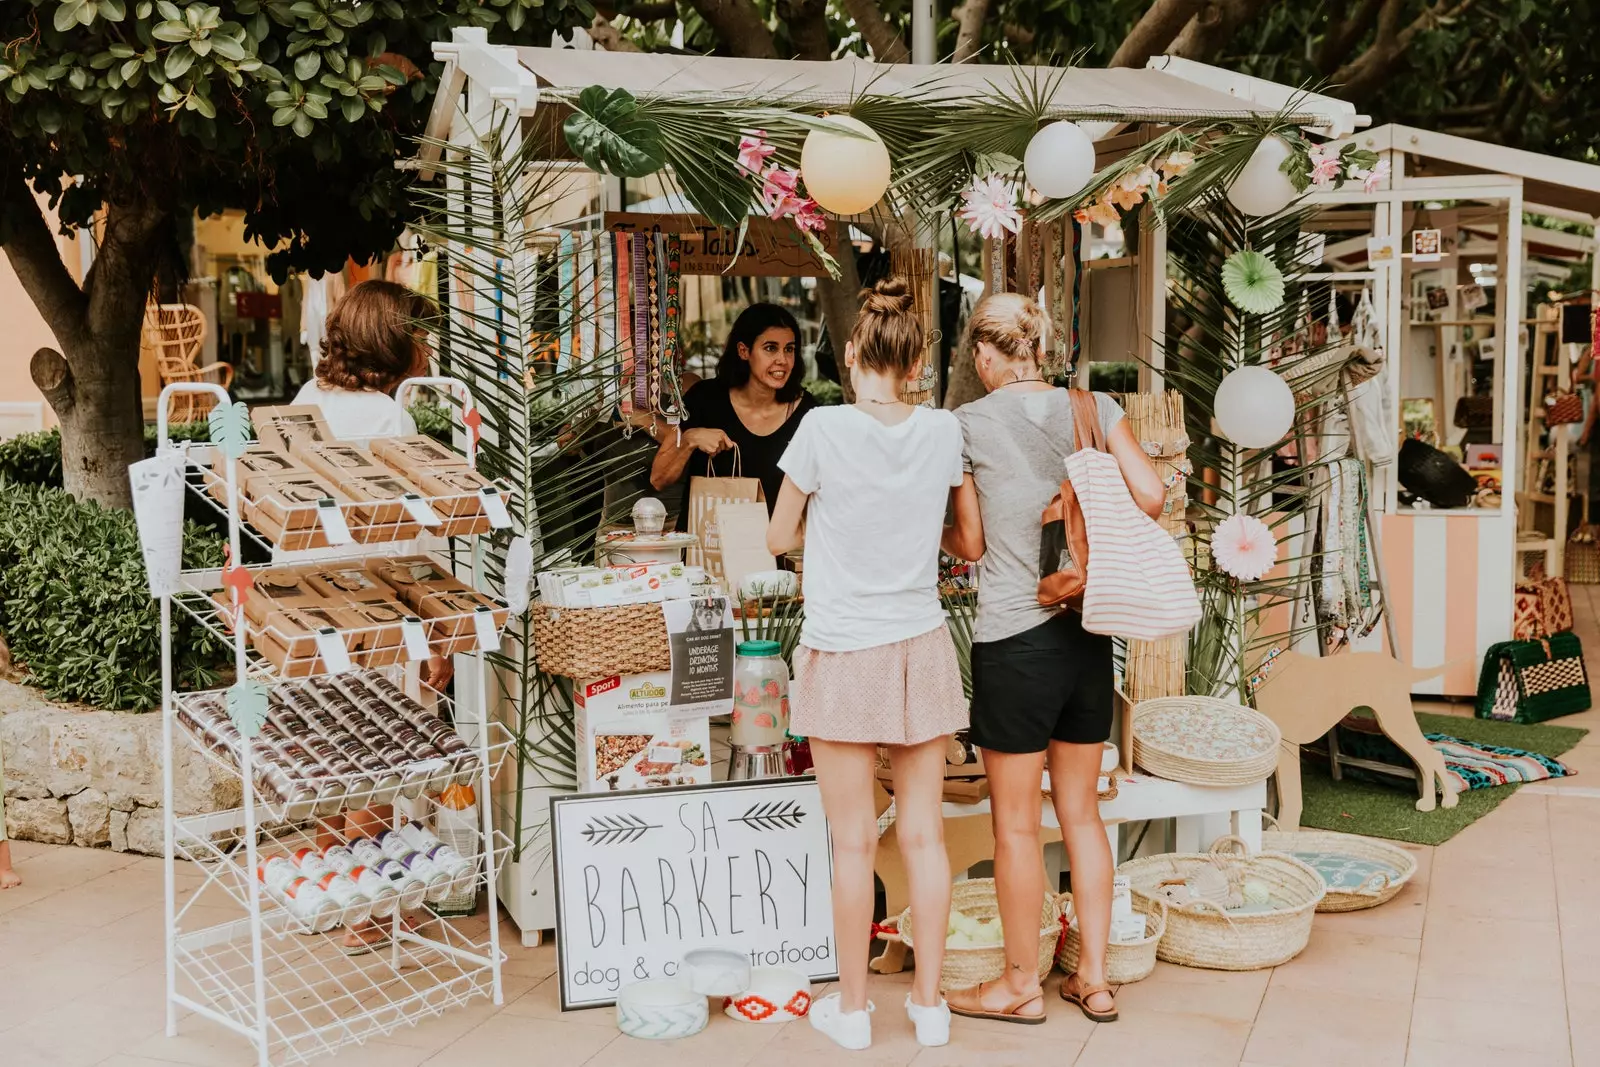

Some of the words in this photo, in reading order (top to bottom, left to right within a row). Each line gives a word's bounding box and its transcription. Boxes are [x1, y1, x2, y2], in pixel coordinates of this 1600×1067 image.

[688, 644, 719, 656] UNDERAGE
[689, 654, 719, 666] DRINKING
[696, 663, 719, 674] MONTHS
[591, 679, 615, 695] Sport
[678, 800, 720, 854] SA
[583, 848, 809, 949] BARKERY
[573, 962, 621, 992] dog
[633, 956, 651, 980] &
[745, 936, 830, 967] trofood
